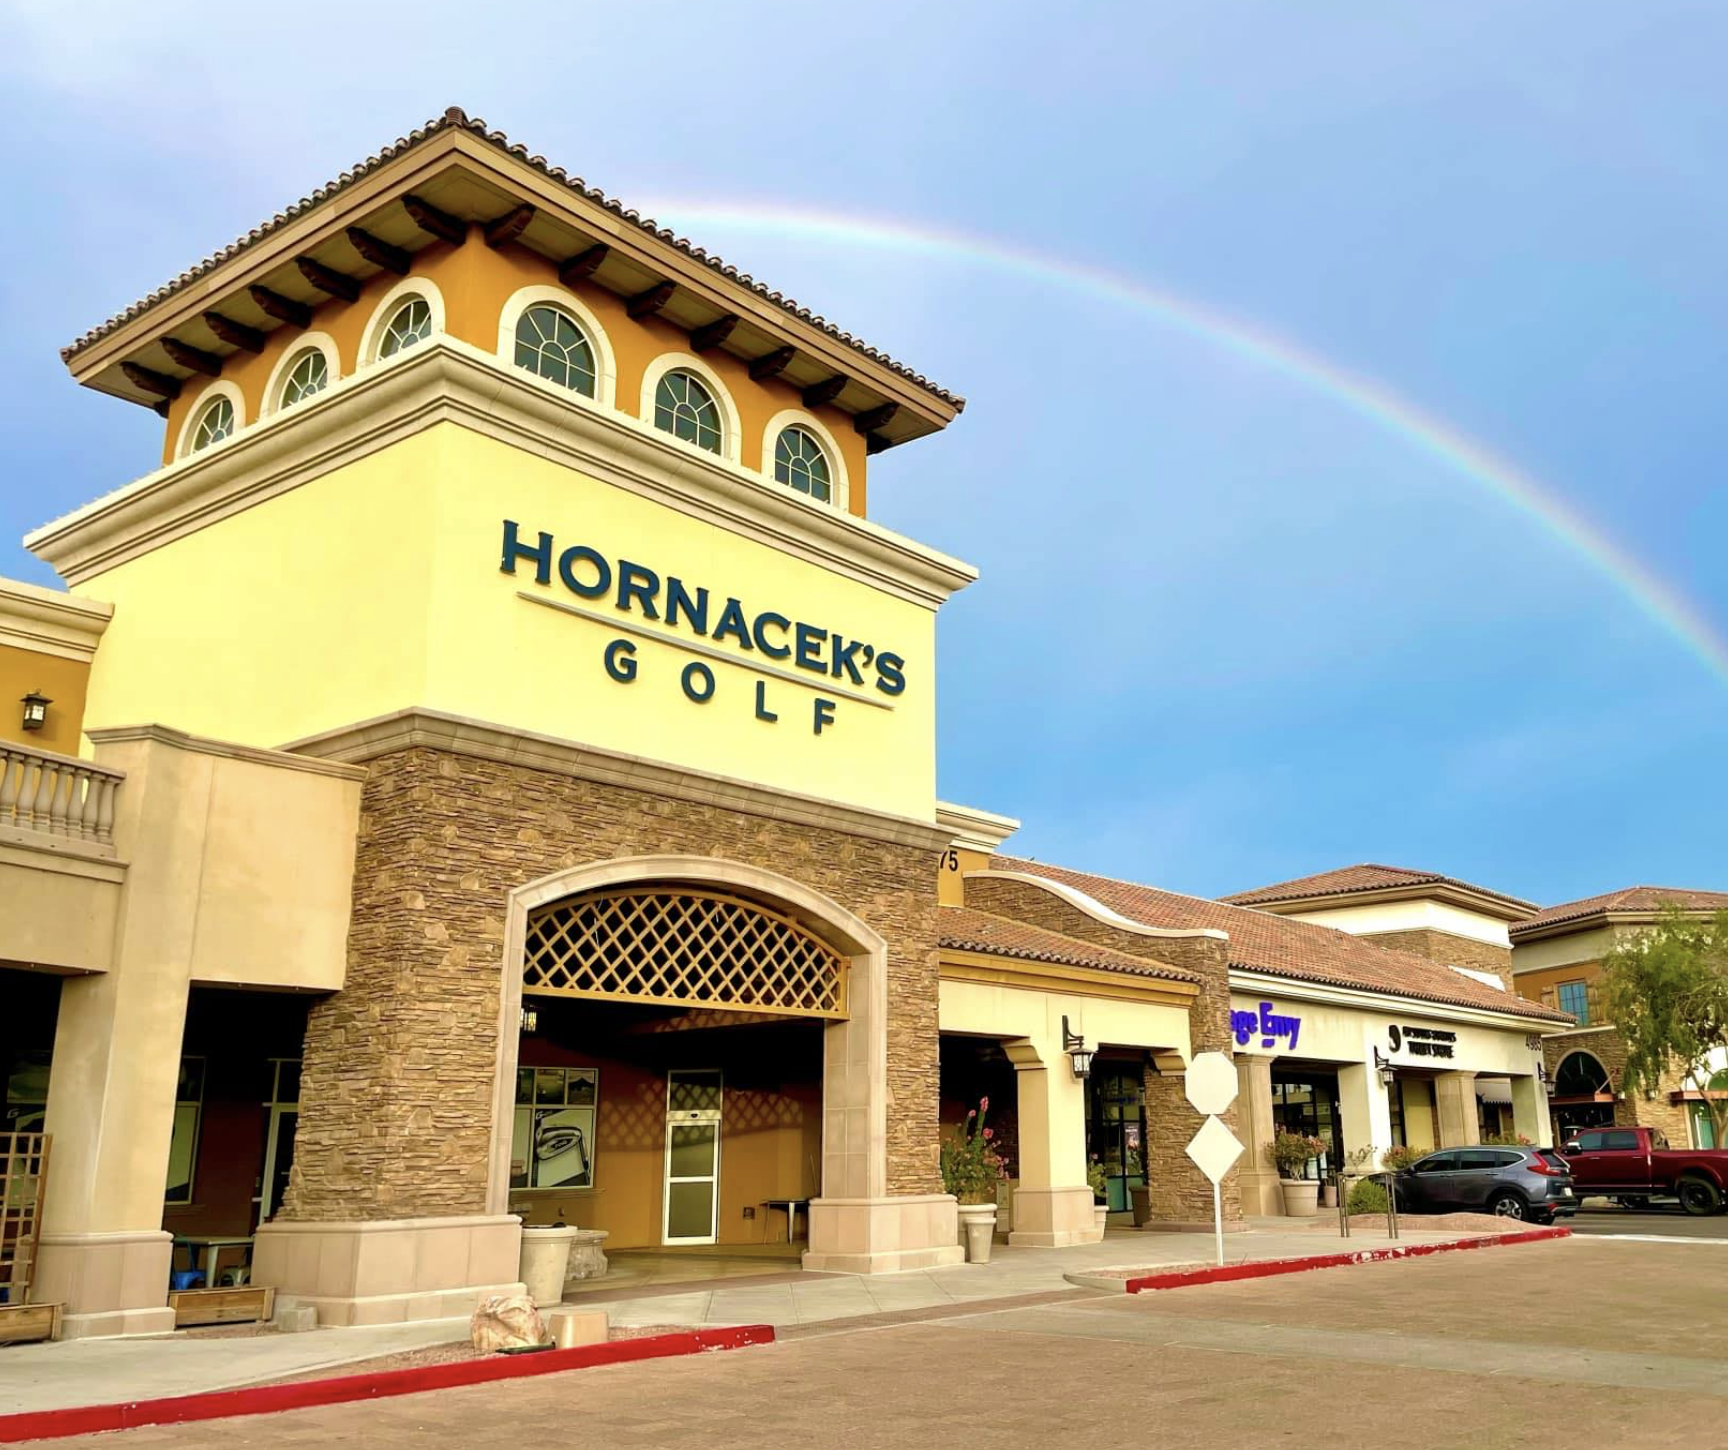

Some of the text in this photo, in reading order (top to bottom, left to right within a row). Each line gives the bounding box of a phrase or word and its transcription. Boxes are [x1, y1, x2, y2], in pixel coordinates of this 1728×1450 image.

[500, 519, 906, 696] HORNACEK'S
[604, 639, 836, 734] GOLF
[1259, 1002, 1301, 1050] Envy
